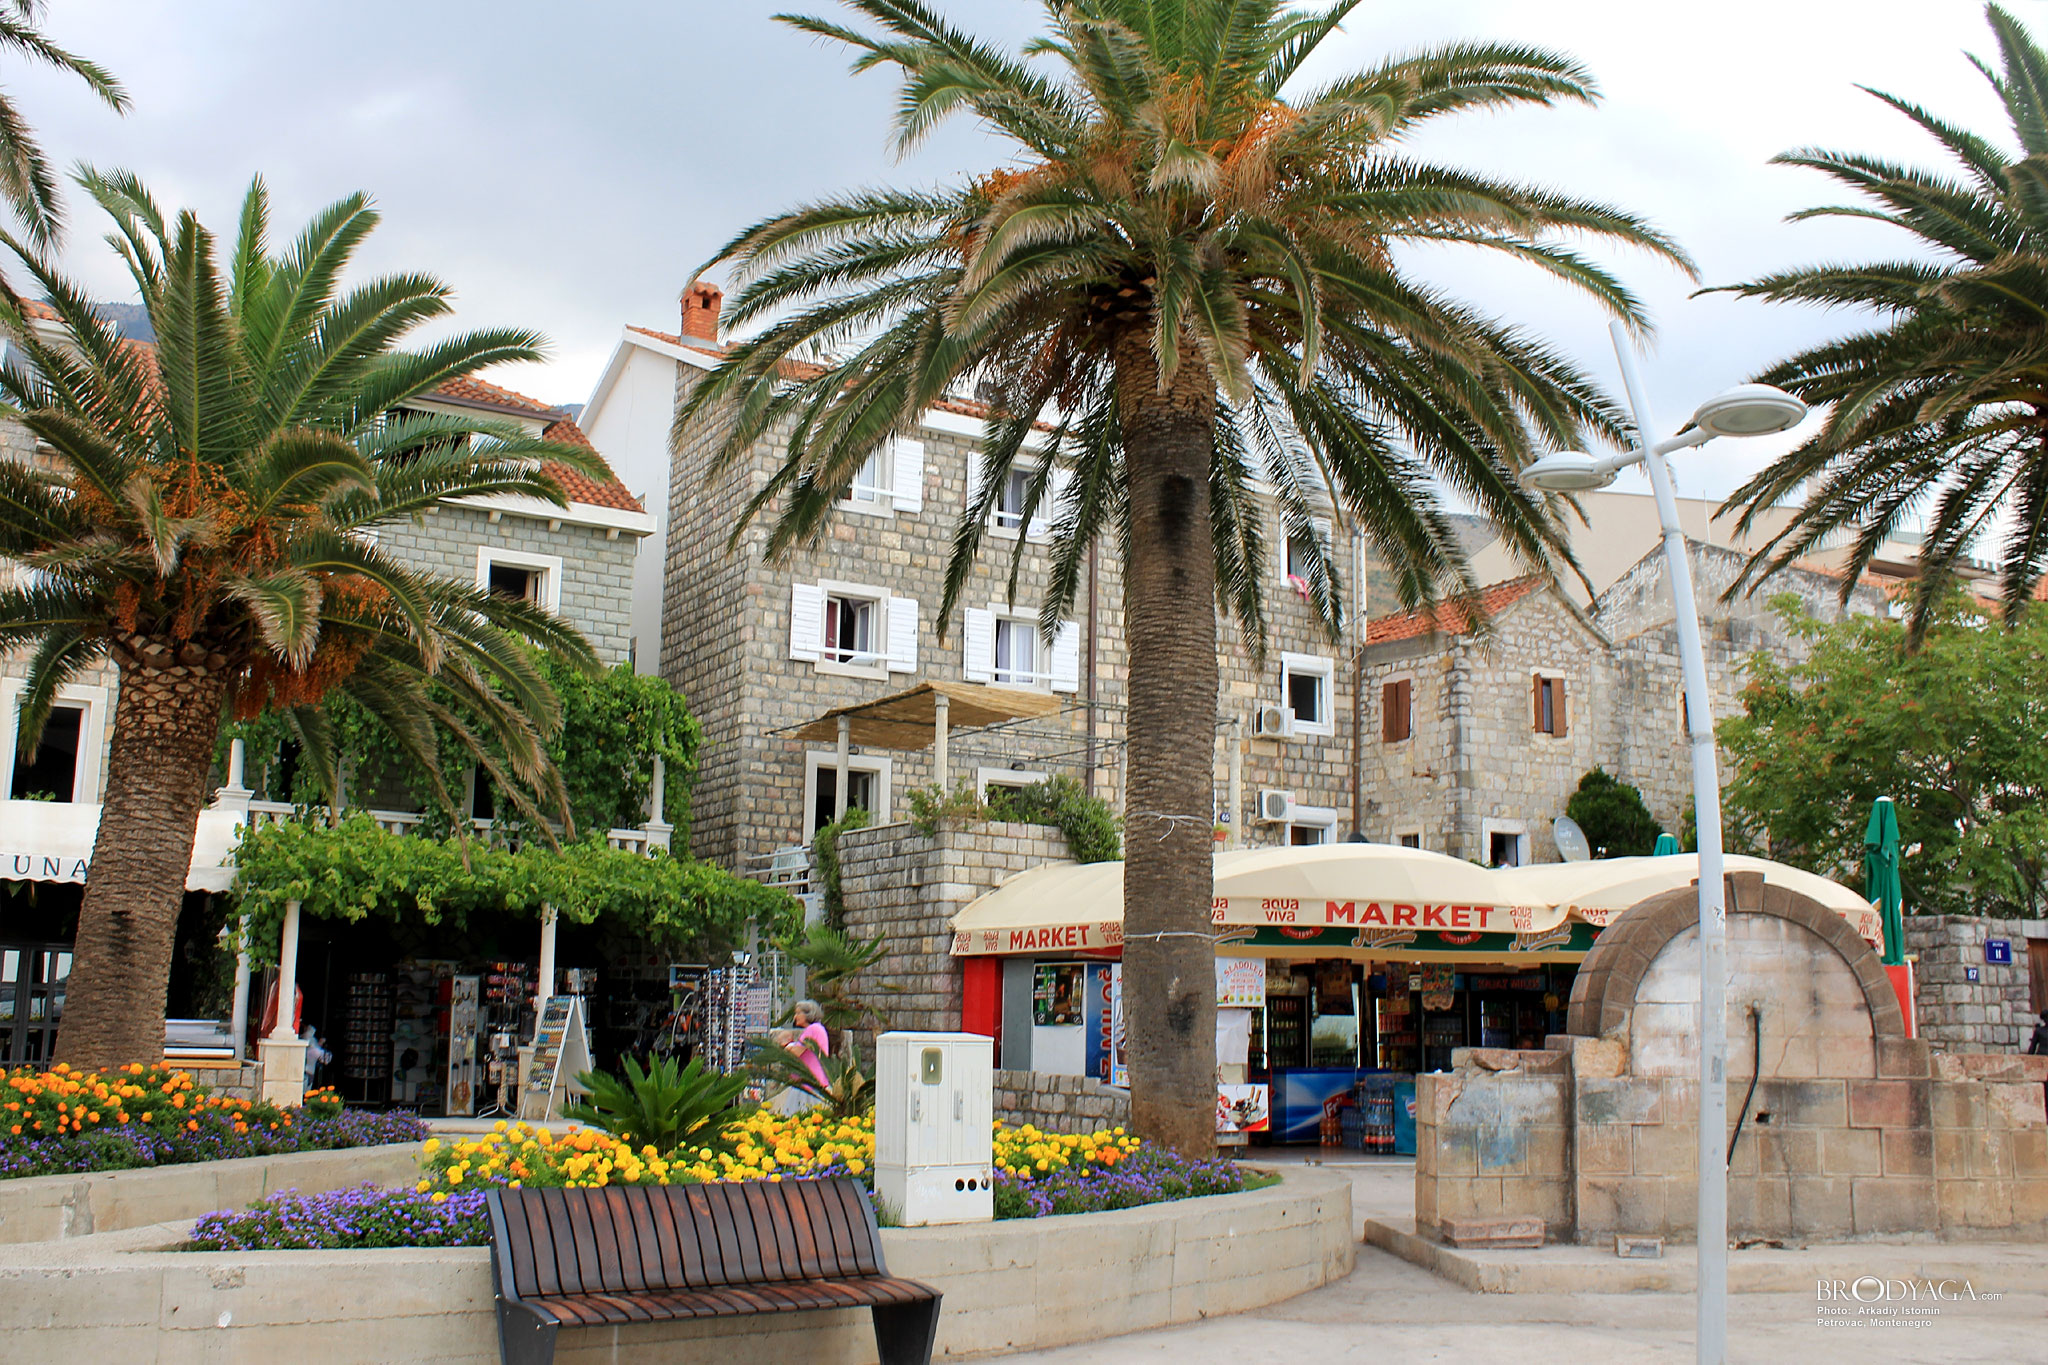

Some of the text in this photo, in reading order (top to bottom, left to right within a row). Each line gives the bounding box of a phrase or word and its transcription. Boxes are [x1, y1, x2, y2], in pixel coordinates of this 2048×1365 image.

[0, 854, 87, 878] UNA
[1211, 898, 1228, 909] ua
[1261, 898, 1299, 910] aqua
[1265, 910, 1296, 922] viva
[1325, 901, 1494, 928] MARKET
[1509, 906, 1532, 918] aqua
[1099, 922, 1121, 932] aqua
[1512, 918, 1532, 930] viva
[955, 932, 971, 942] aqua
[984, 930, 999, 941] aqua
[1009, 924, 1090, 950] MARKET
[1102, 932, 1123, 944] viva
[956, 942, 969, 952] viva
[984, 941, 998, 952] viva
